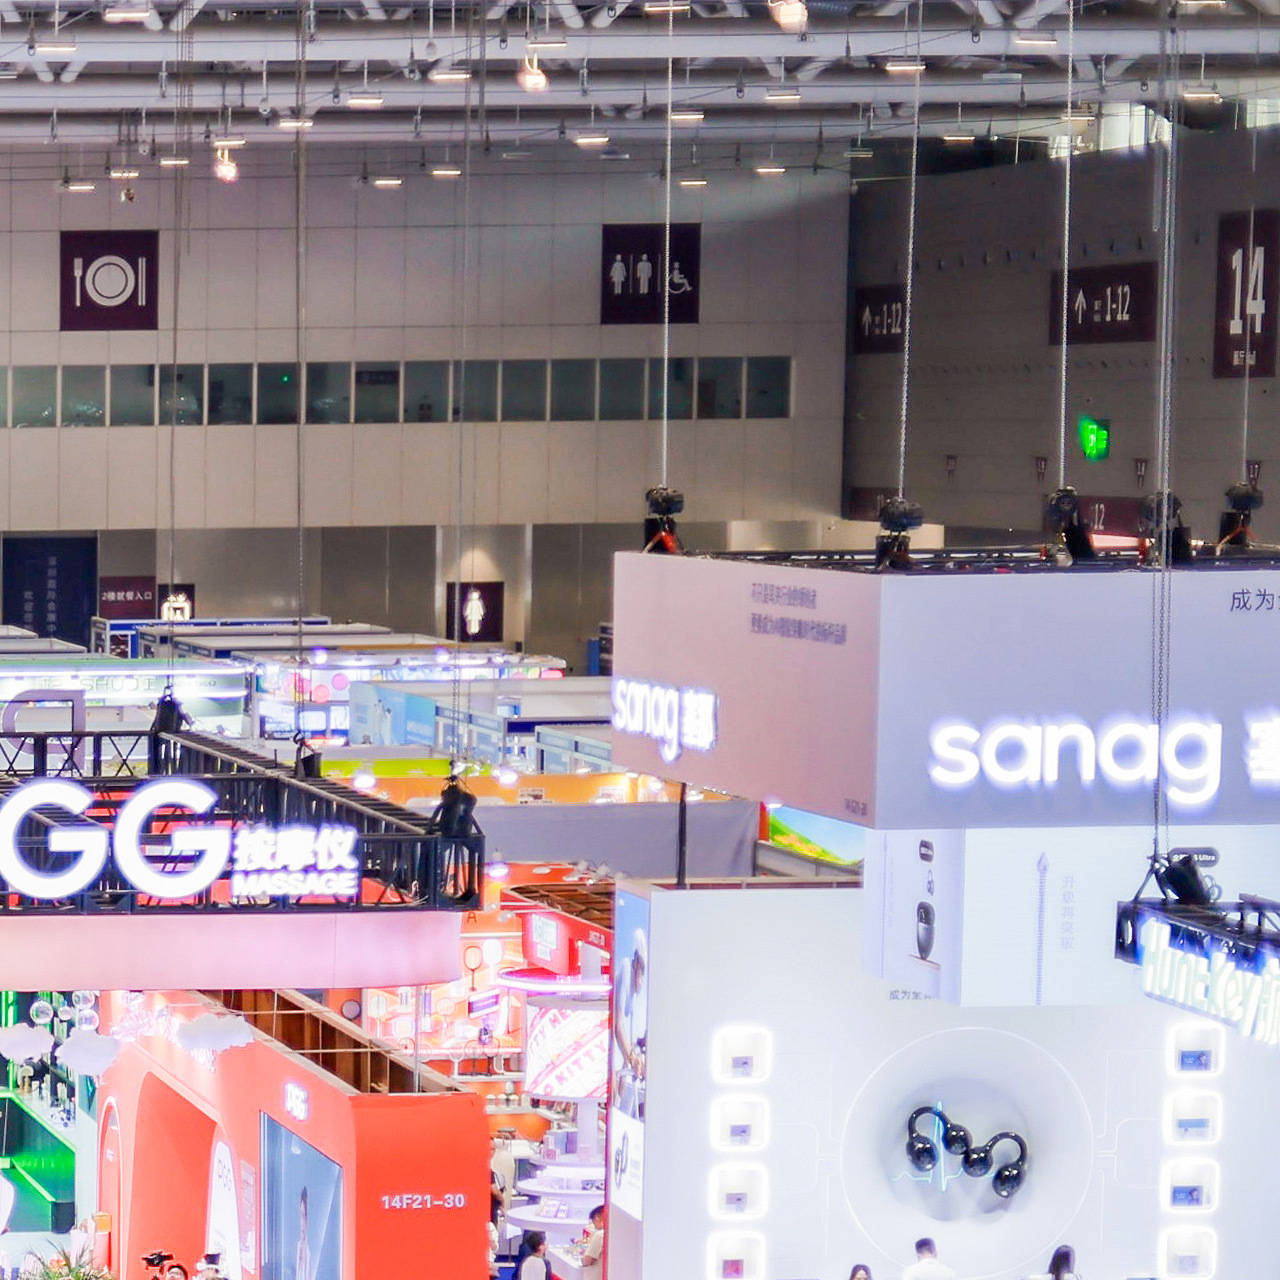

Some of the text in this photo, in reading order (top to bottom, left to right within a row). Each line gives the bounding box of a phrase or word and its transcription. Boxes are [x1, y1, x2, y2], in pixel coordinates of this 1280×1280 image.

[1230, 246, 1266, 334] 14
[1230, 588, 1280, 612] 成为
[932, 720, 1222, 804] sanag
